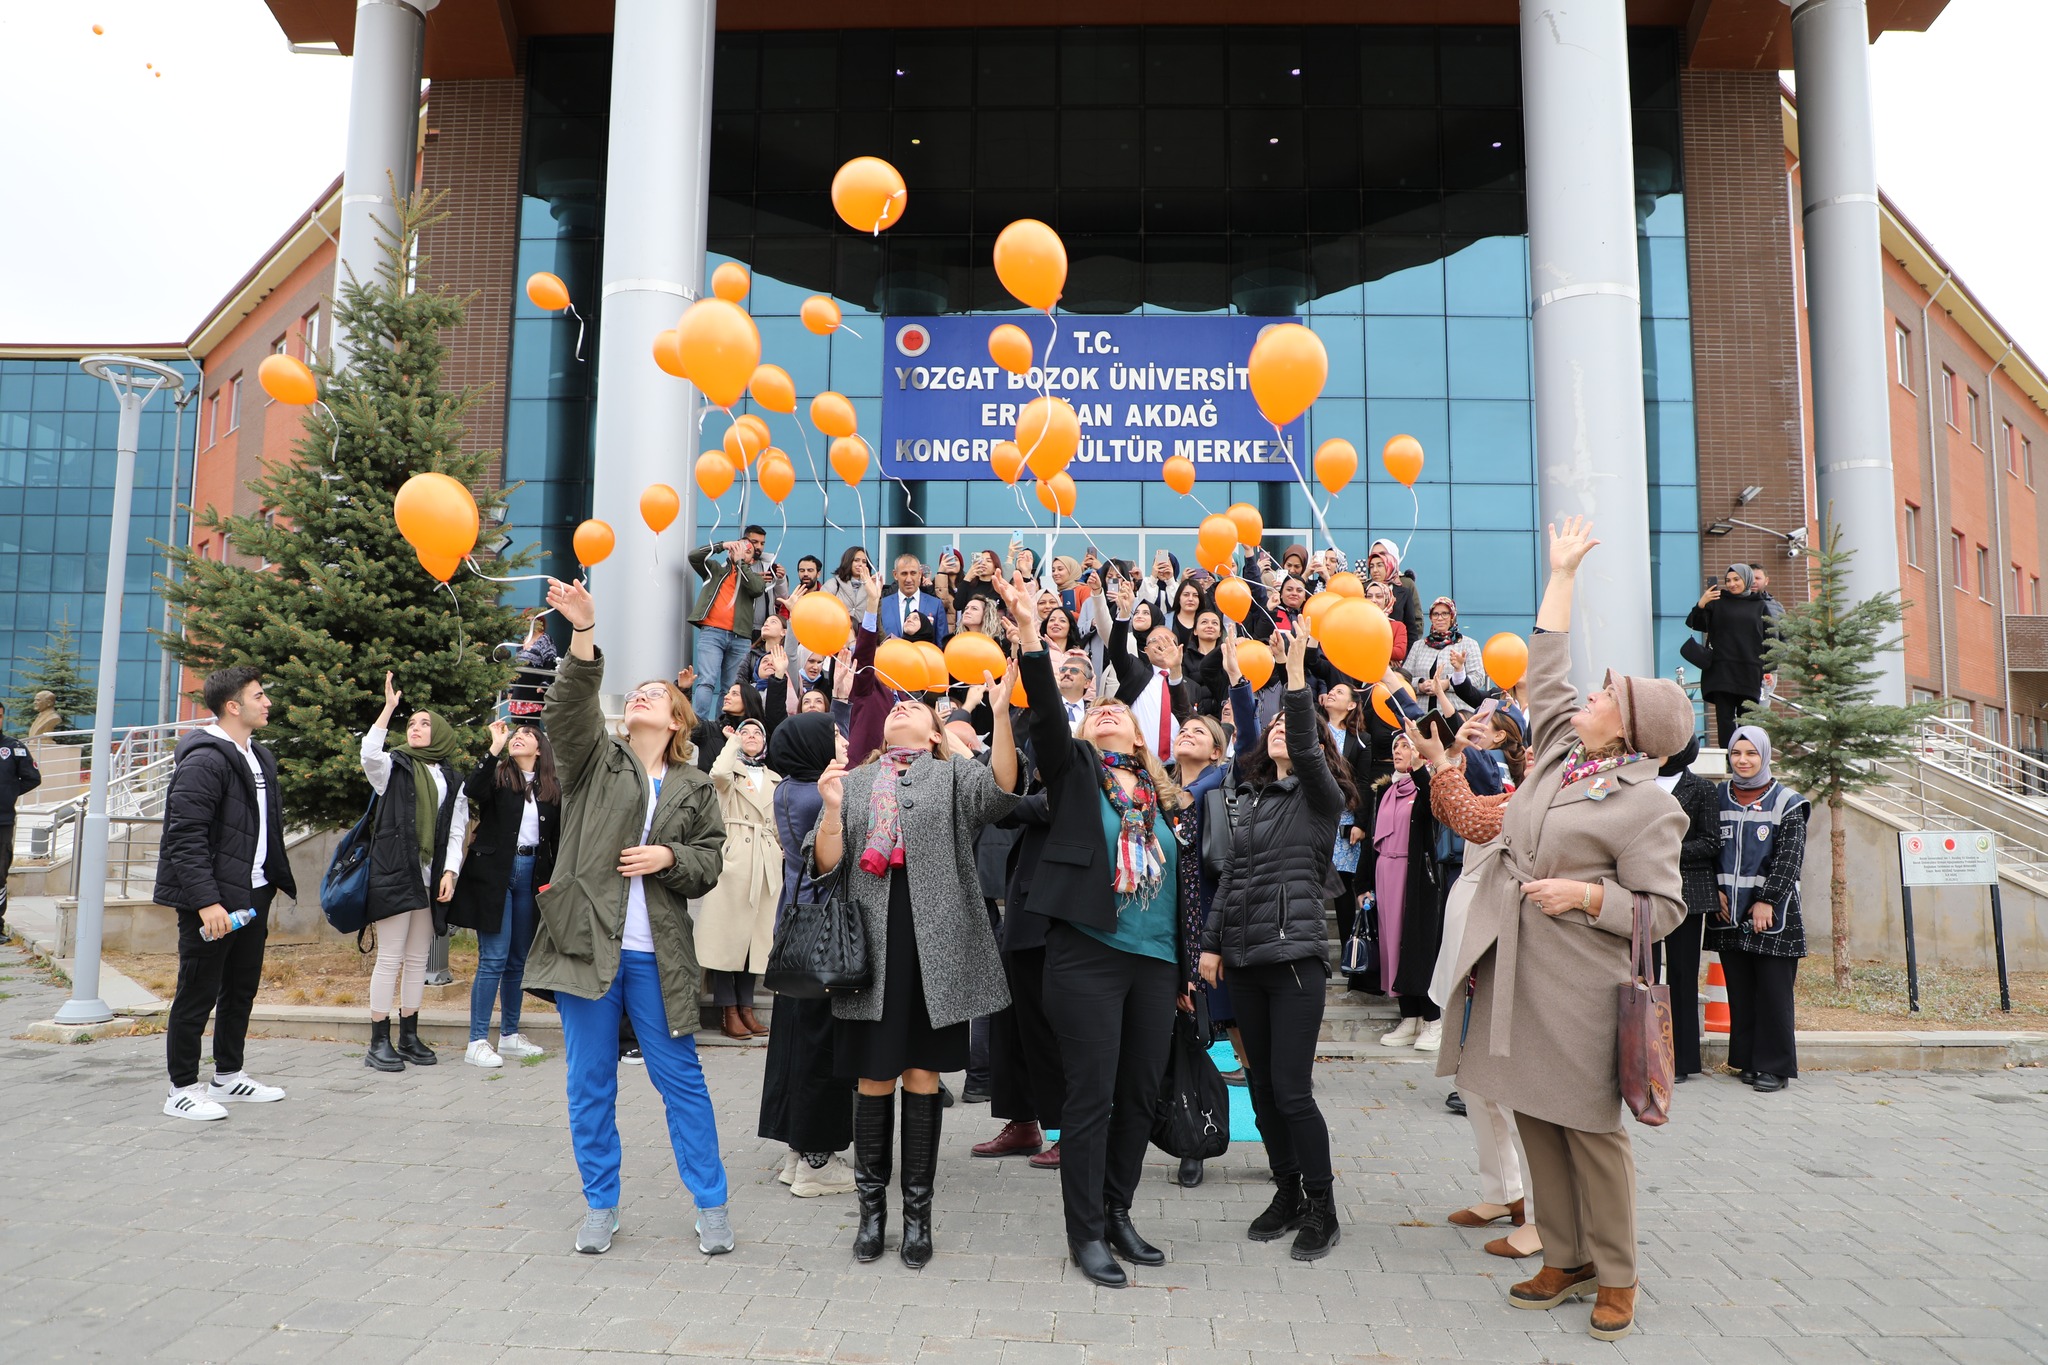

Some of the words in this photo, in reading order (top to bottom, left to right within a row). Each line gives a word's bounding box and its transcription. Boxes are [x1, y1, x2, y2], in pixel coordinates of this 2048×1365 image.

[1073, 330, 1120, 354] T.C.
[894, 366, 999, 390] YOZGAT
[1007, 366, 1100, 390] BOZOK
[1109, 362, 1249, 390] ÜNİVERSİT
[981, 397, 1112, 427] ERAN
[1125, 398, 1218, 427] AKDAĞ
[1068, 435, 1164, 463] ÜLTÜR
[1174, 434, 1294, 463] MERKEZİ
